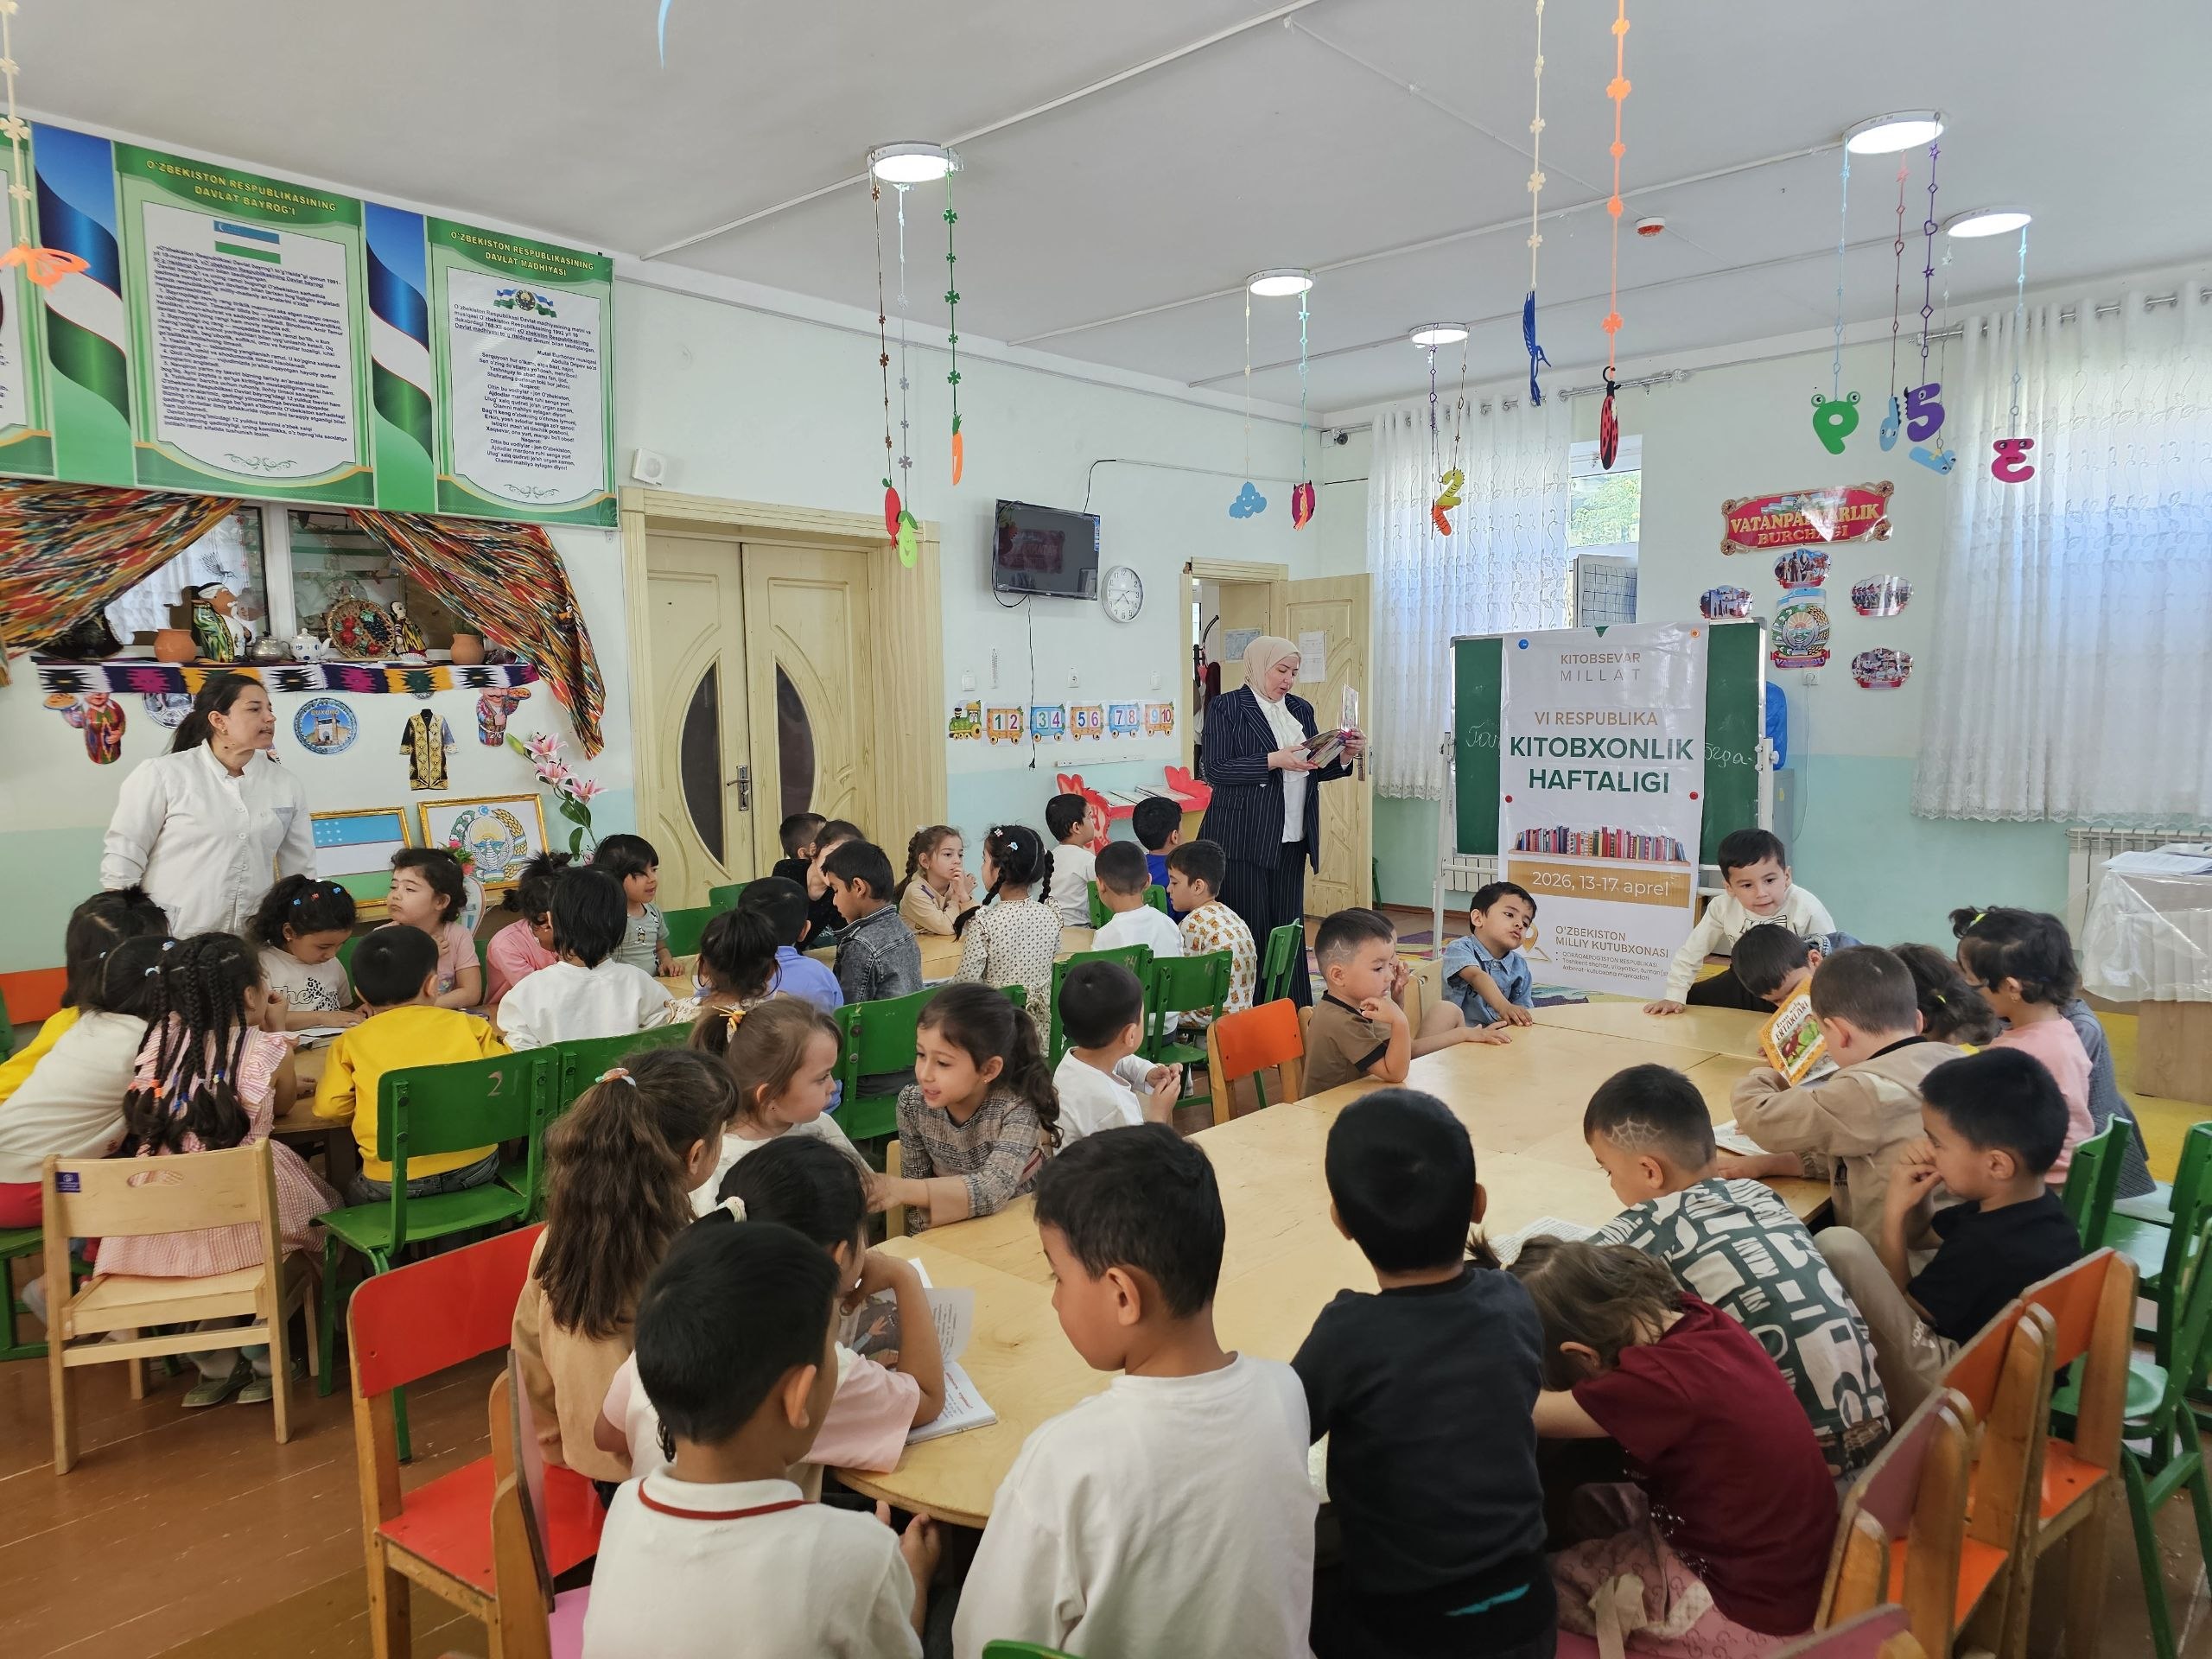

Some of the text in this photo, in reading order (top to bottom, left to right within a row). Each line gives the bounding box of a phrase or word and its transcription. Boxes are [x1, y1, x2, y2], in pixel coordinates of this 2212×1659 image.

[194, 185, 240, 204] DAVLAT
[228, 178, 336, 212] RESPUBLIKASINING
[485, 251, 566, 276] DAVLAT MADHIYASI
[512, 245, 594, 270] RESPUBLIKASINING
[1905, 383, 1945, 442] 5
[1560, 652, 1641, 664] KITOBSEVAR
[1560, 669, 1640, 682] MILLAT
[995, 715, 1017, 729] 1 2
[1039, 712, 1059, 728] 3 4
[1078, 712, 1098, 727] 5 6
[1116, 710, 1135, 724] 7 8
[1152, 709, 1171, 723] 9 10
[1535, 712, 1658, 726] VI RESPUBLIKA
[1510, 736, 1694, 760] KITOBXONLIK
[1529, 769, 1669, 793] HAFTALIGI
[1533, 872, 1575, 891] 2026,
[1624, 881, 1669, 896] aprel
[1555, 925, 1626, 941] O'ZBEKISTON
[1555, 937, 1669, 958] MILLIY KUTUBXONASI
[1611, 964, 1639, 973] viloyatlar,
[1620, 958, 1658, 968] RESPUBLIKASI
[1563, 965, 1649, 981] Axborot-kutubxona markazlari
